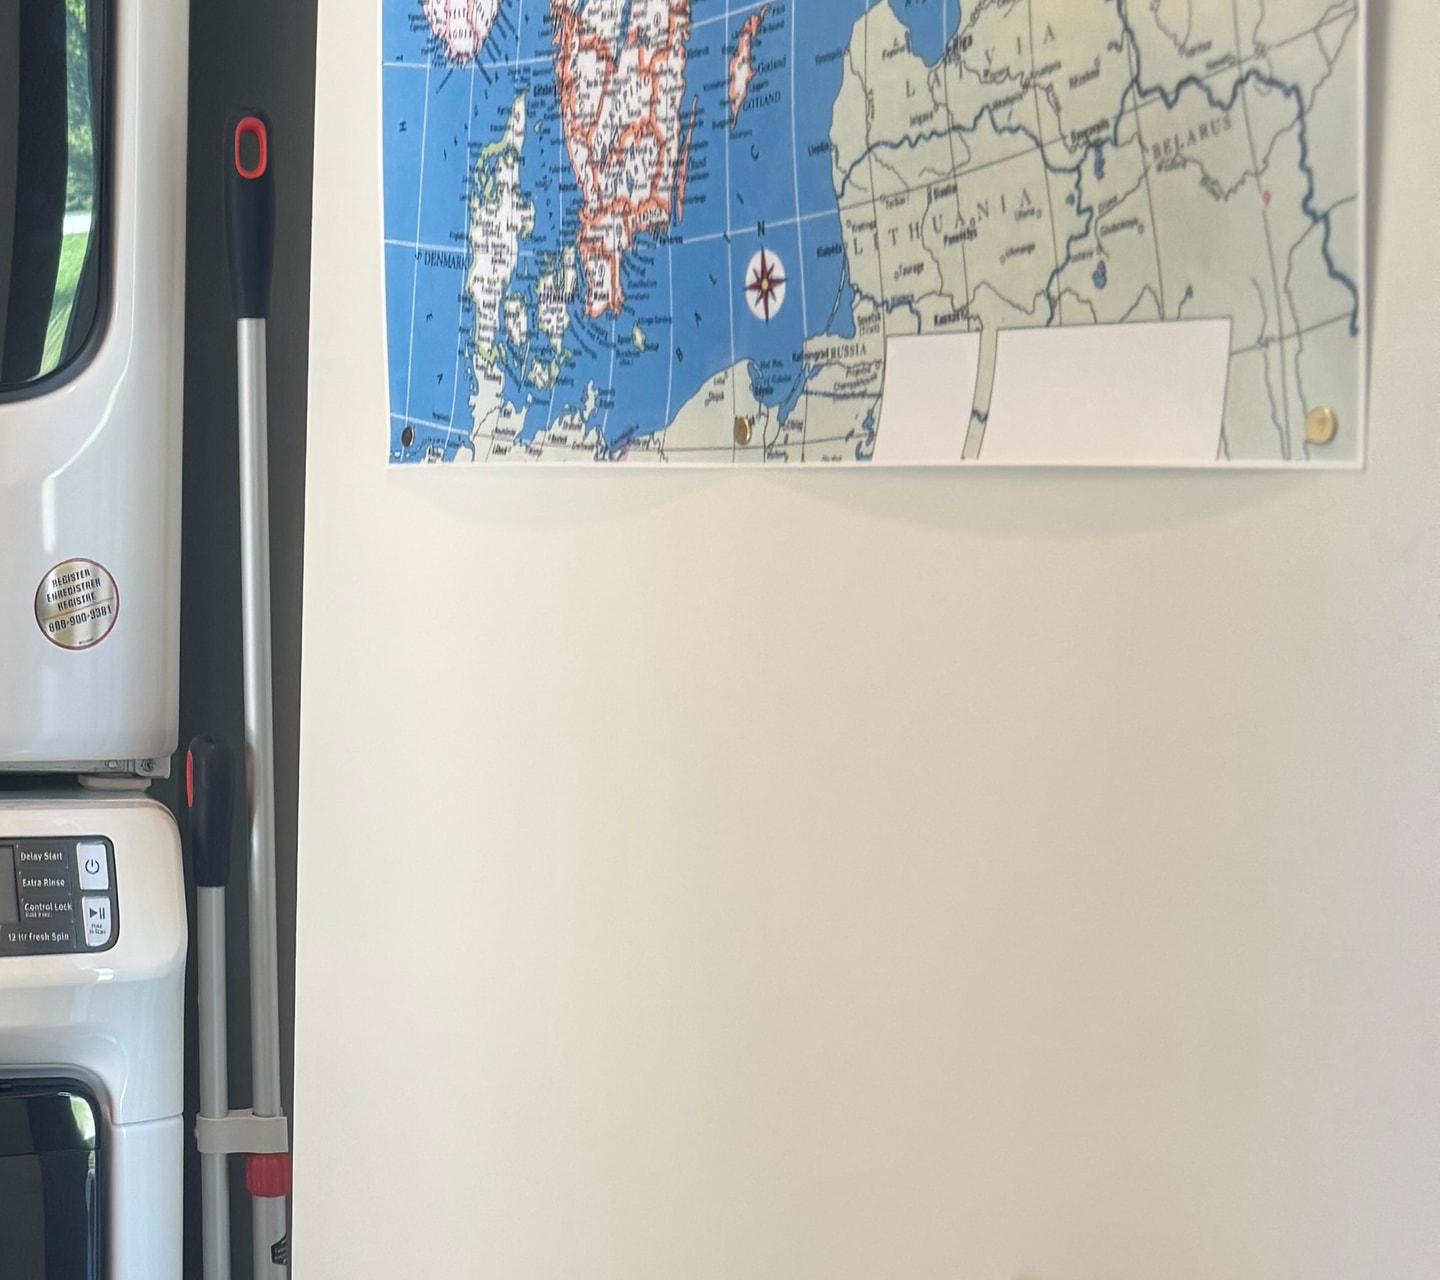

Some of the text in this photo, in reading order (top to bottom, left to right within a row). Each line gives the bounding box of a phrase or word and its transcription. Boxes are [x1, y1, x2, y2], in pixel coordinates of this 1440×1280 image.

[742, 91, 781, 113] GOTLAND
[1152, 115, 1233, 159] BELARUS
[424, 250, 468, 273] DENMARK
[830, 343, 867, 360] RUSSIA
[52, 568, 90, 588] REGISTER
[47, 577, 101, 602] ENREGISTRER
[20, 851, 63, 862] Delay Start
[22, 878, 65, 887] Extra Rinse
[24, 902, 73, 911] Control Lock
[8, 931, 69, 942] 12 Hr Fresh Spin
